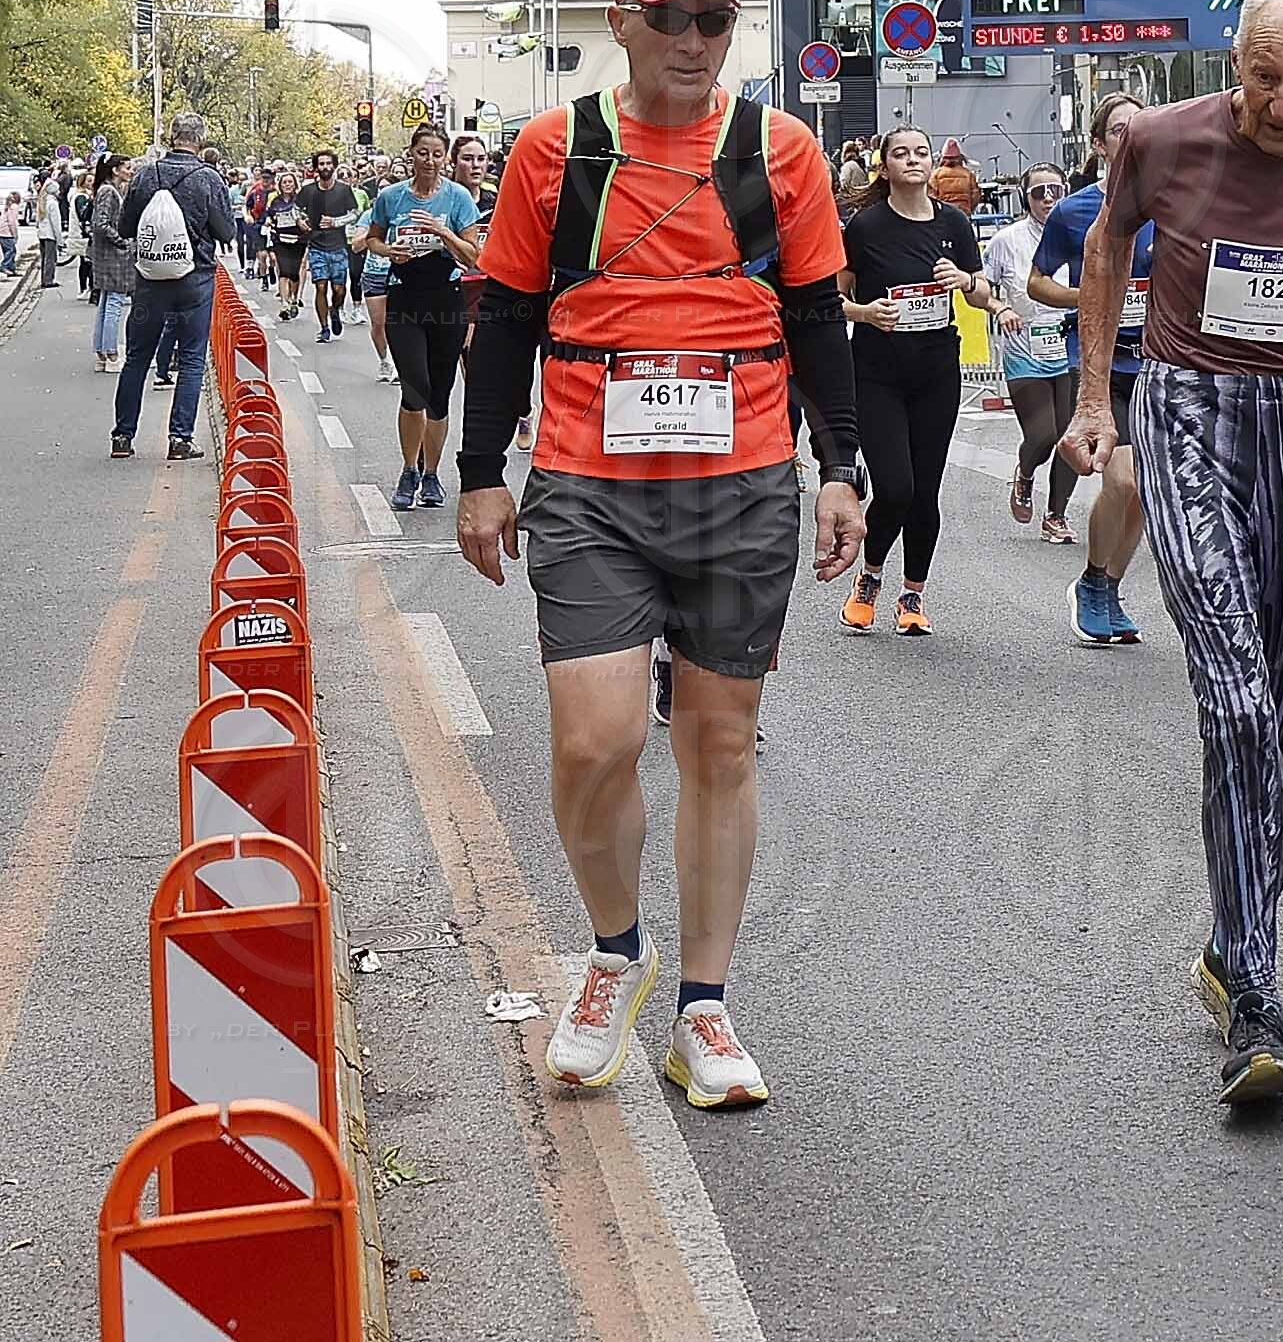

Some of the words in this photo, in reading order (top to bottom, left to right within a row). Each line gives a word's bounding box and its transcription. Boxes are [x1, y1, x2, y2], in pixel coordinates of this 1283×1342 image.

[975, 26, 1046, 46] STUNDE
[1056, 26, 1068, 43] €
[411, 102, 421, 116] H
[409, 236, 430, 245] 2142
[907, 298, 935, 311] 3924
[632, 366, 678, 376] MARATHON
[640, 384, 701, 406] 4617
[654, 421, 687, 431] Gerald
[237, 617, 287, 638] NAZIS
